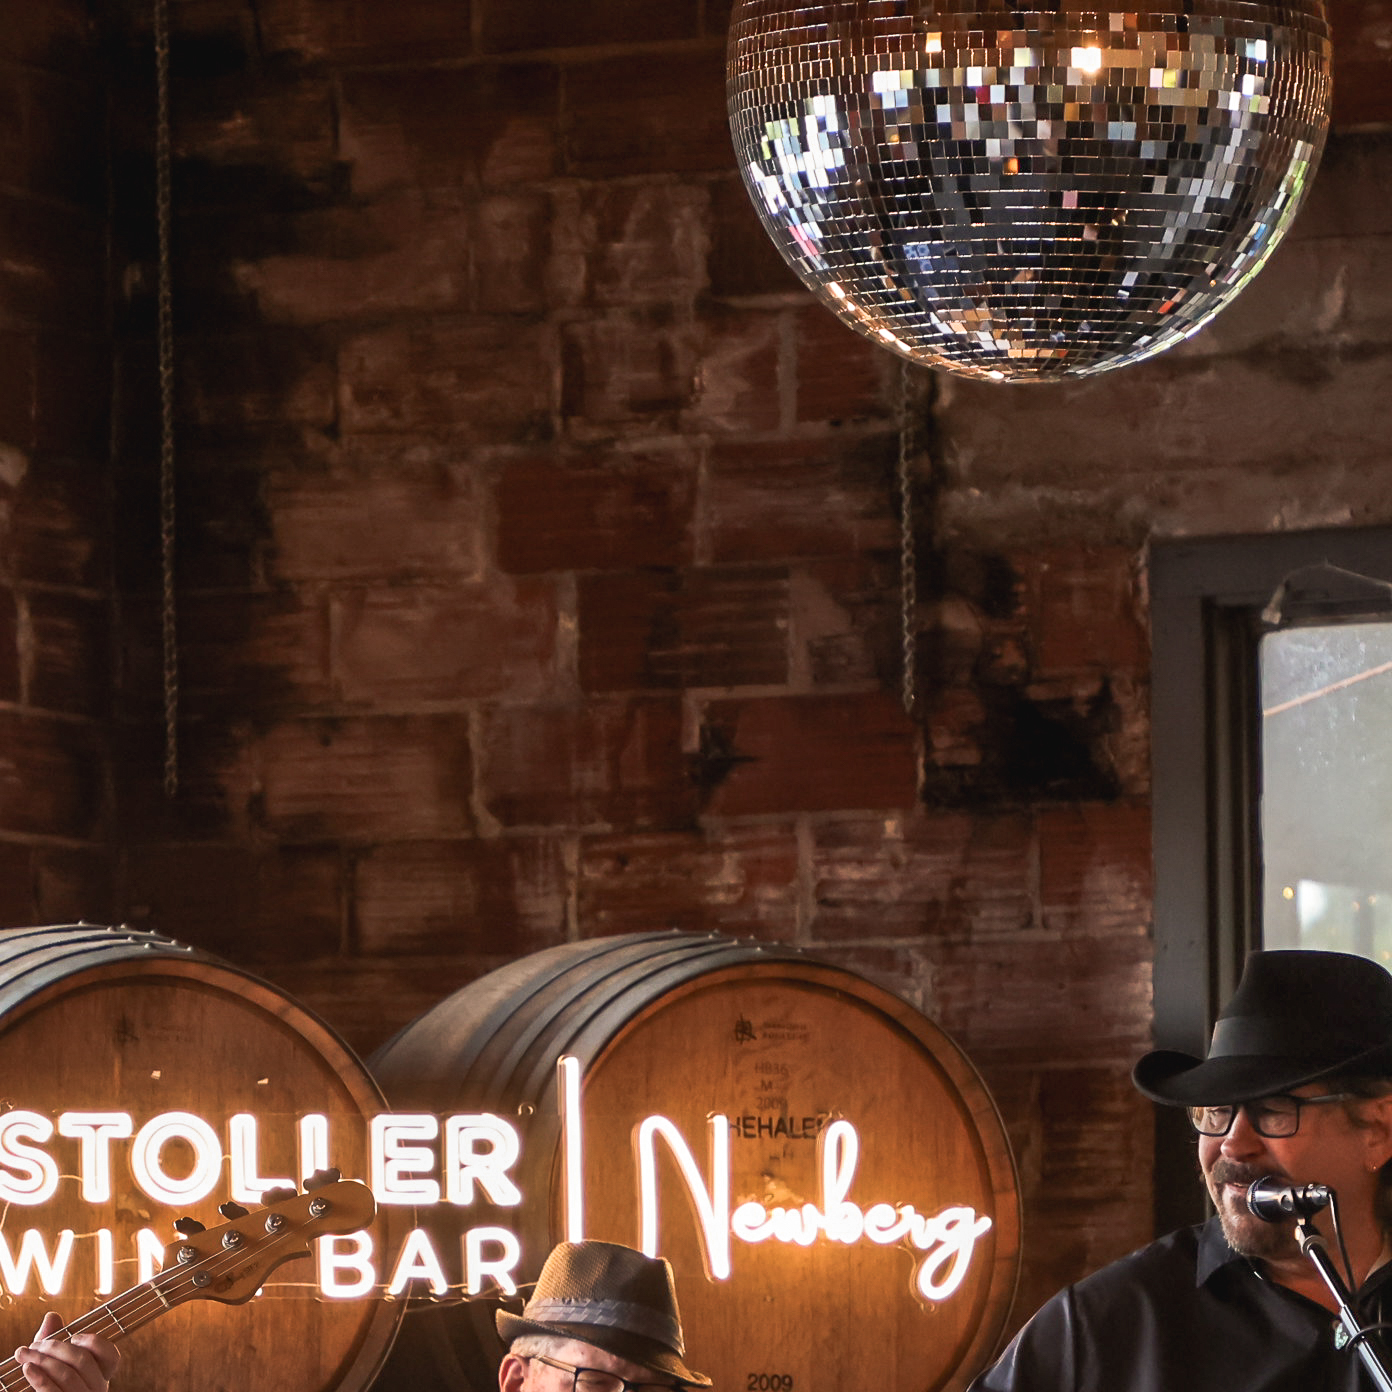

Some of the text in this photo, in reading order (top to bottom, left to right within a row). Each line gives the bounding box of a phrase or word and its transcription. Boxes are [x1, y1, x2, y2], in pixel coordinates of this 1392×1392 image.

[636, 1111, 993, 1302] Newberg
[318, 1227, 519, 1299] BAR
[747, 1373, 793, 1392] 2009
